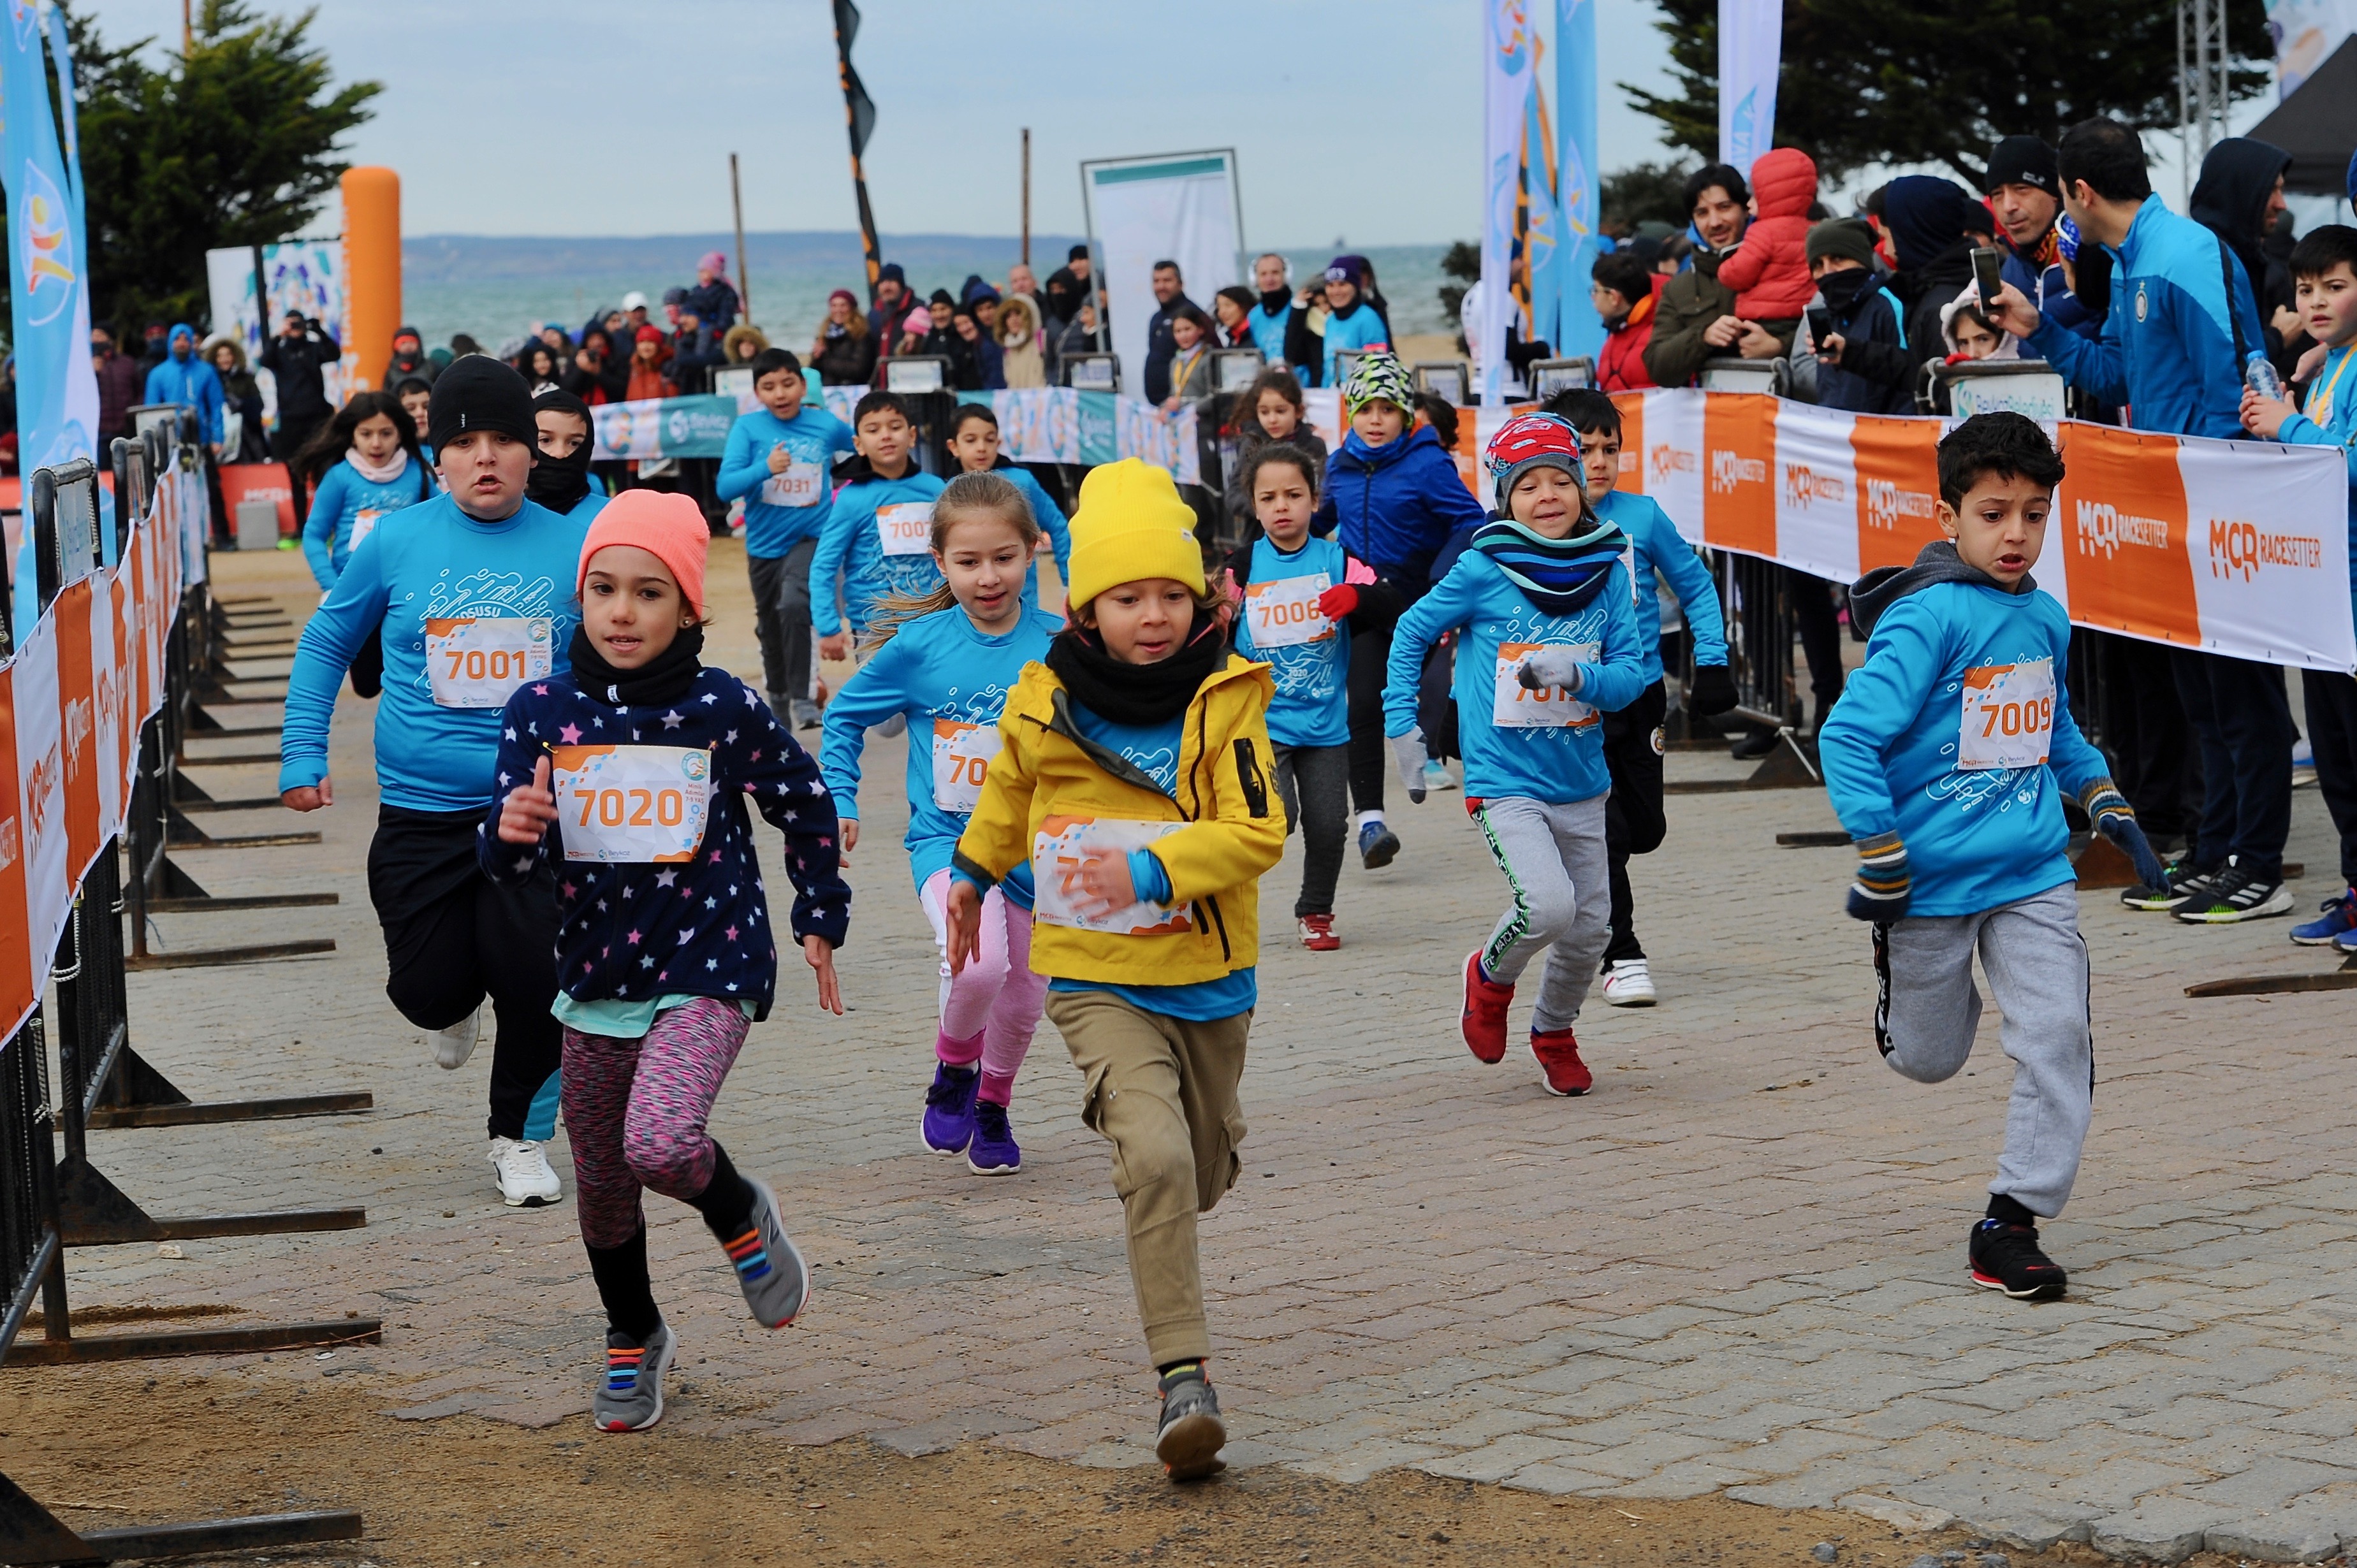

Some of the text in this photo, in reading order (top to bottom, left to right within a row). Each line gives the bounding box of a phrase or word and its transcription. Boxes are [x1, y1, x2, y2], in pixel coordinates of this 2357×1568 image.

[775, 478, 810, 493] 7031
[2076, 499, 2168, 560] MCR RACESETTER
[2210, 519, 2321, 583] MCR RACESETTER
[455, 606, 501, 619] OSUSU
[1258, 599, 1320, 628] 7006
[445, 650, 525, 680] 7001
[1980, 697, 2051, 737] 7009
[949, 754, 988, 787] 70
[574, 788, 682, 827] 7020
